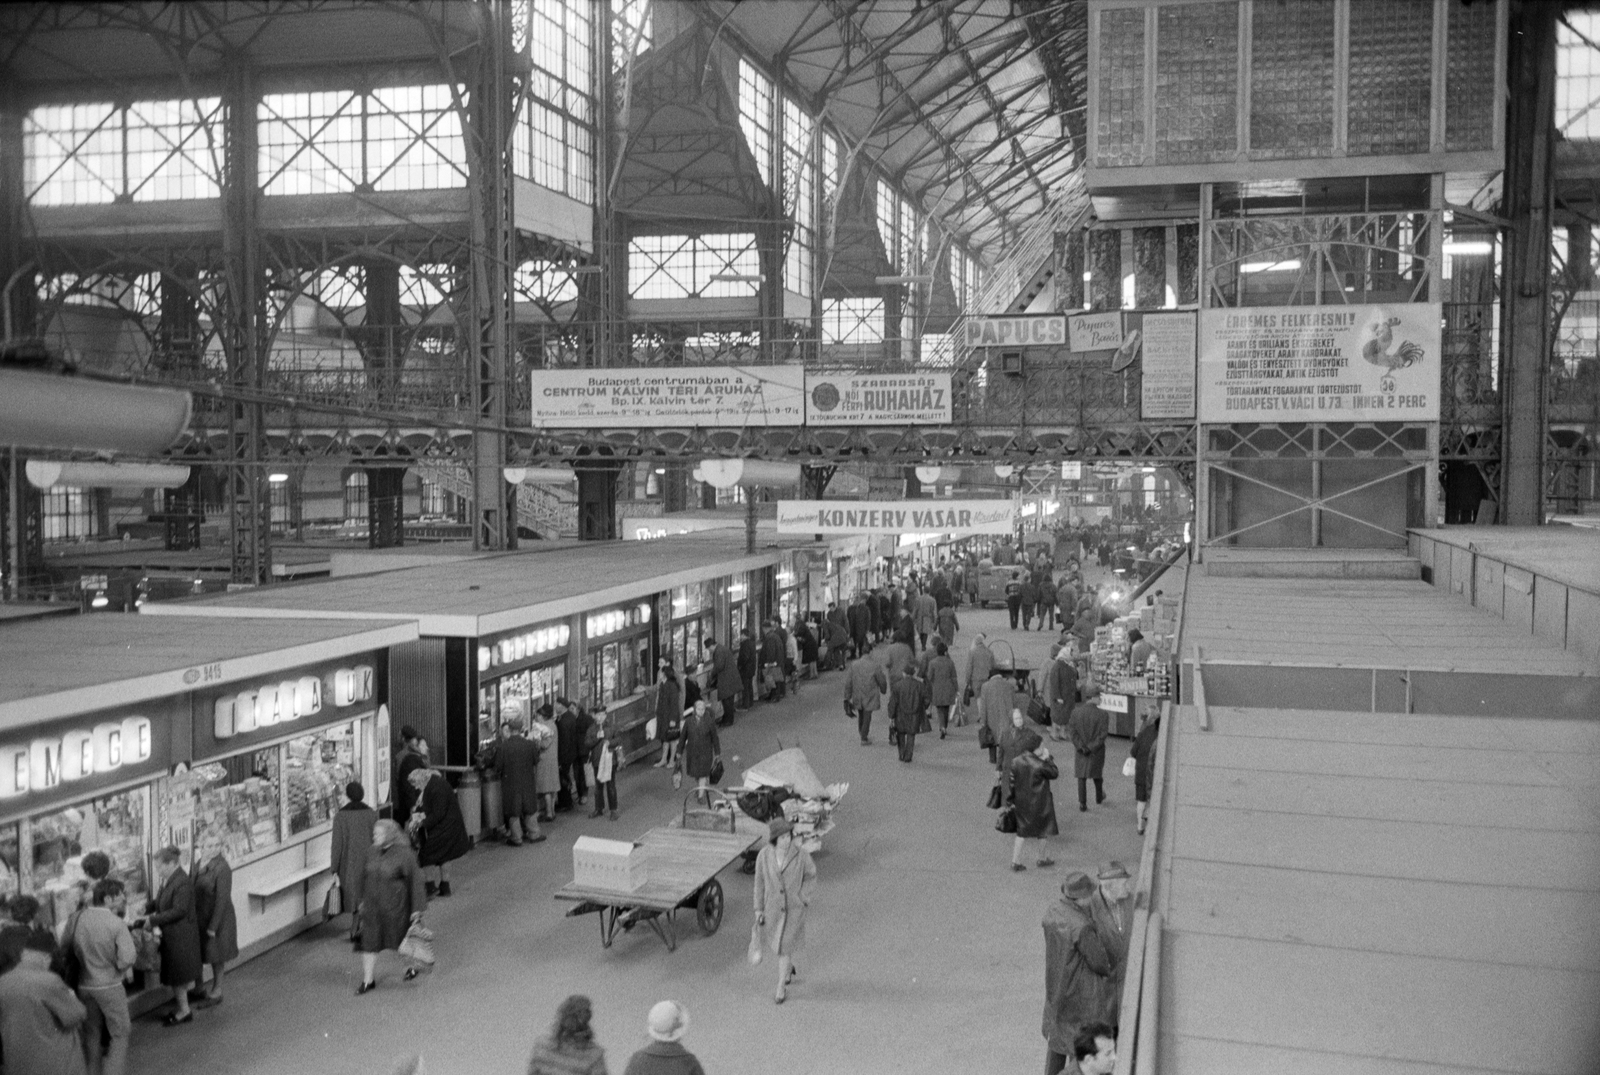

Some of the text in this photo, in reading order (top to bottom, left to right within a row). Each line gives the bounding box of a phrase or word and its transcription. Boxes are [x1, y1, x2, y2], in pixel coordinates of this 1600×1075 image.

[1074, 319, 1115, 332] Papucs
[1227, 315, 1276, 328] ÉRDEMES
[967, 319, 1062, 344] PAPUCS
[1249, 339, 1257, 349] ÉS
[589, 377, 641, 386] Budapest
[644, 376, 729, 386] centrumában
[851, 377, 935, 388] SZABADSÁG
[543, 387, 607, 397] CENTRUM
[864, 386, 946, 411] RUHAHÁZ
[1353, 396, 1384, 409] INNEN
[1388, 395, 1395, 408] 2
[1399, 395, 1426, 408] PERC
[819, 509, 906, 528] KONZERV
[912, 507, 971, 528] VÁSÁR
